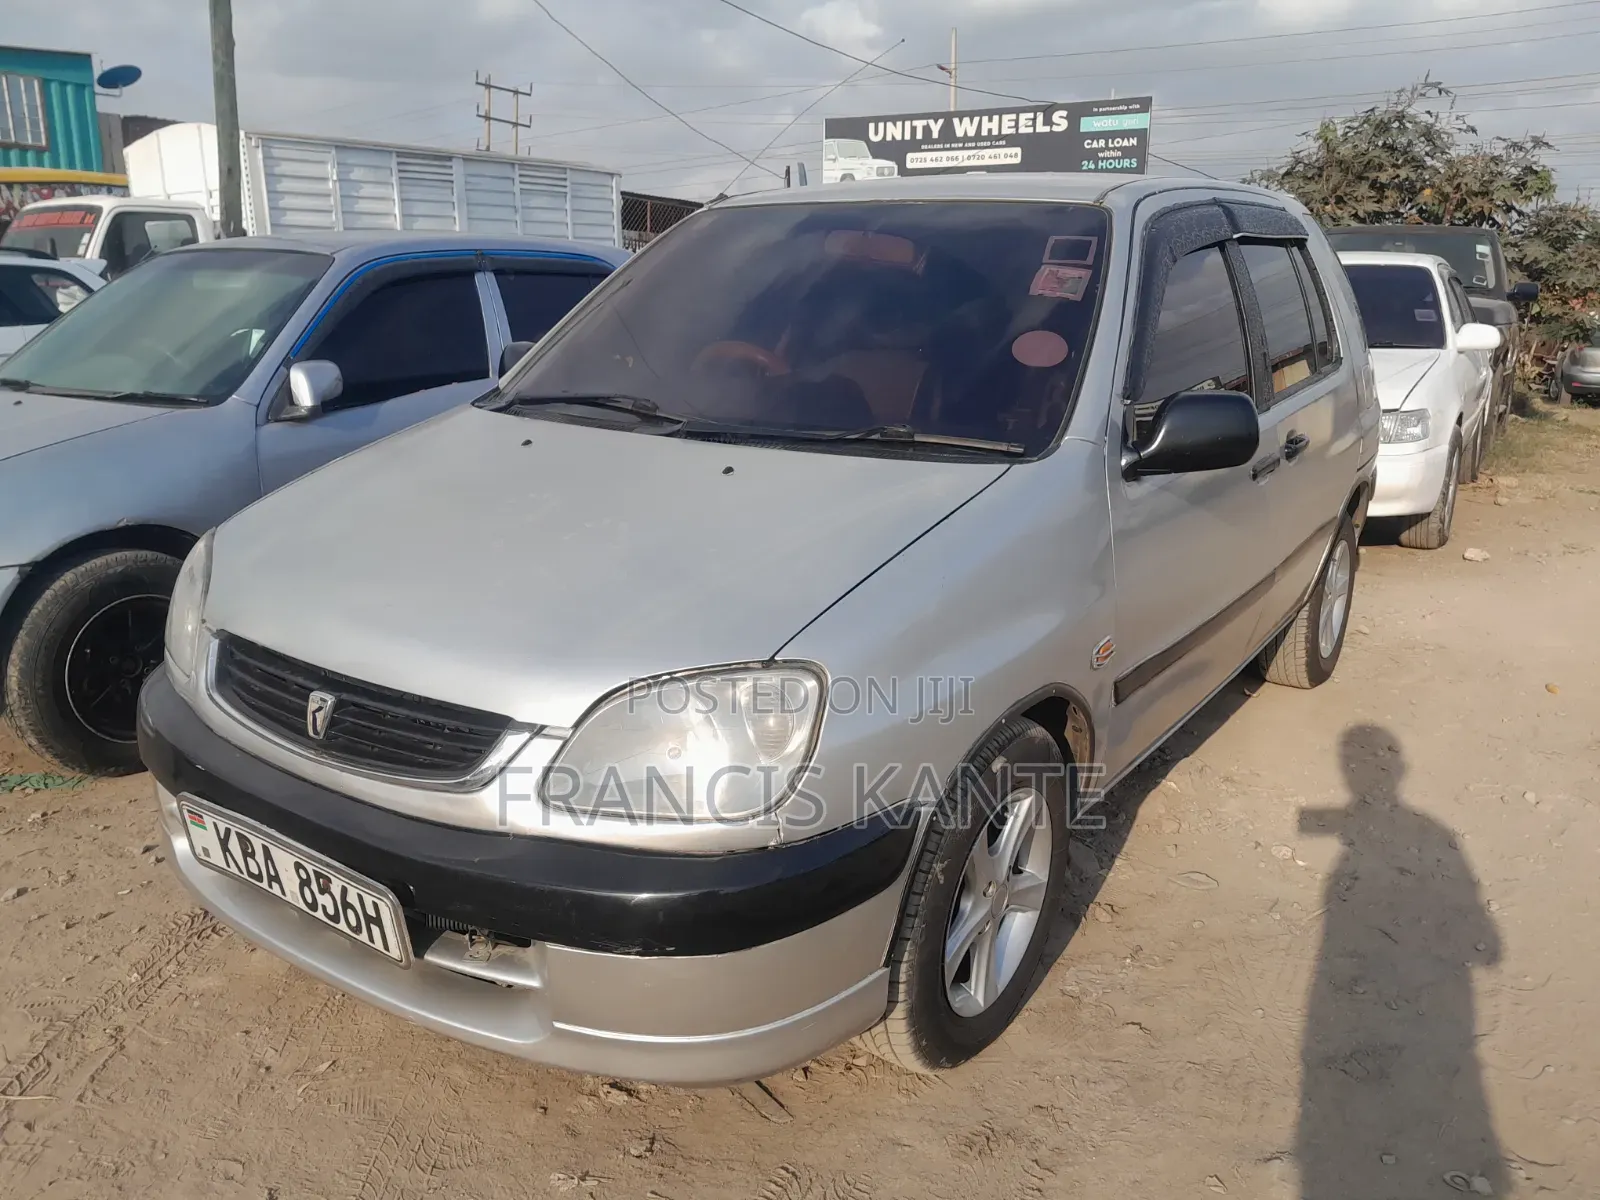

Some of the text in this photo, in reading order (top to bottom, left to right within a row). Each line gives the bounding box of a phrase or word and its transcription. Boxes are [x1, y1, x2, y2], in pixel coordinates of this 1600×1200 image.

[868, 110, 1069, 142] UNITY WHEELS
[1093, 118, 1119, 127] watu
[1083, 137, 1138, 149] CAR LOAN
[1097, 149, 1122, 158] within
[1081, 158, 1138, 170] 24 HOURS
[212, 820, 391, 954] KBA 856H
